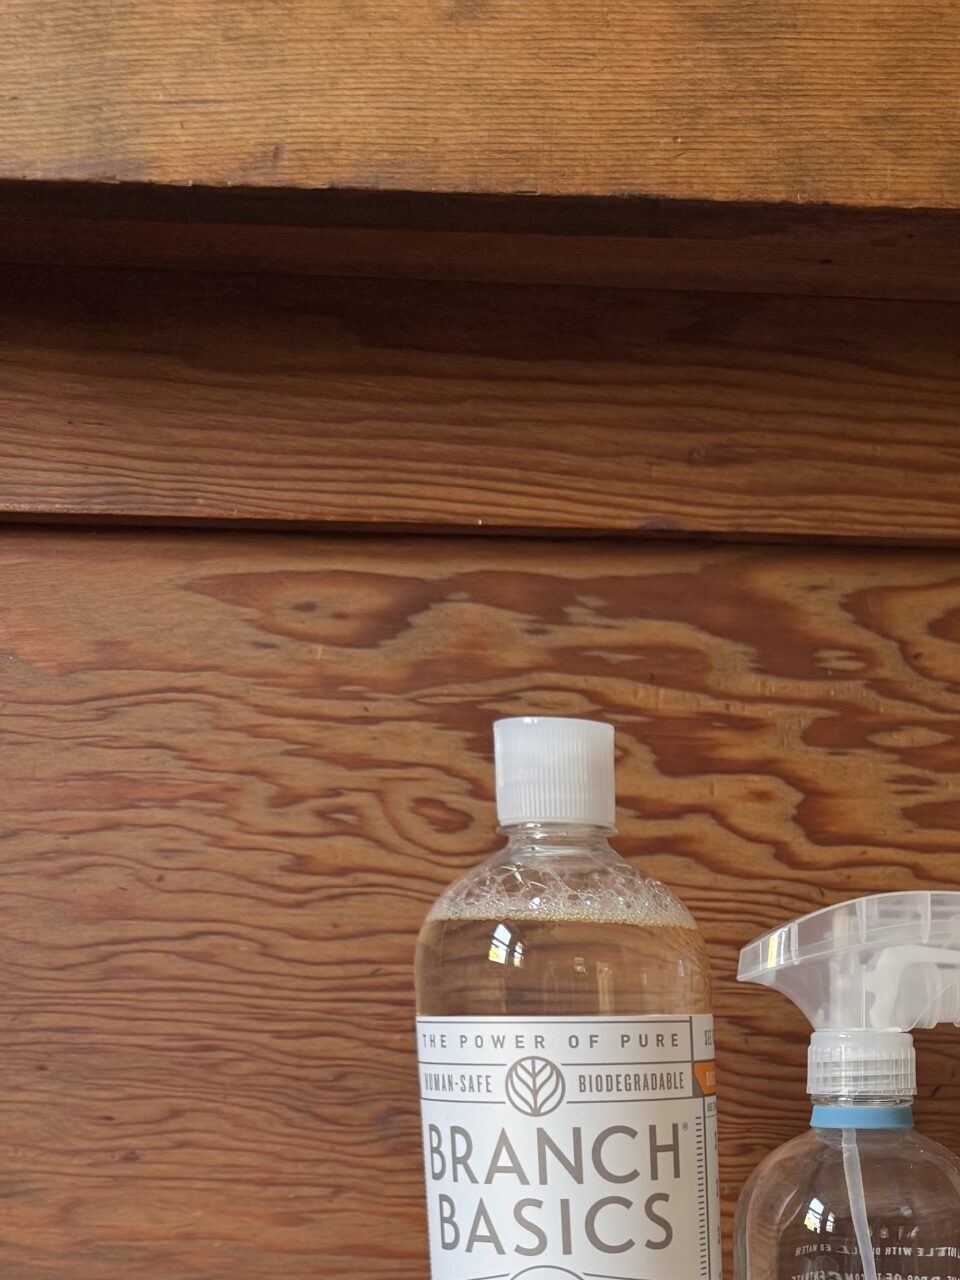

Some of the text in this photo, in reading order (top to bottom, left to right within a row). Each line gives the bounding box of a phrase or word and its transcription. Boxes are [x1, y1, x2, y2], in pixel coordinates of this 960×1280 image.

[422, 1033, 679, 1050] THE POWER OF PURE
[424, 1072, 493, 1093] HUMAN-SAFE
[578, 1071, 685, 1093] BIODEGRADABLE
[438, 1192, 674, 1257] BASICS
